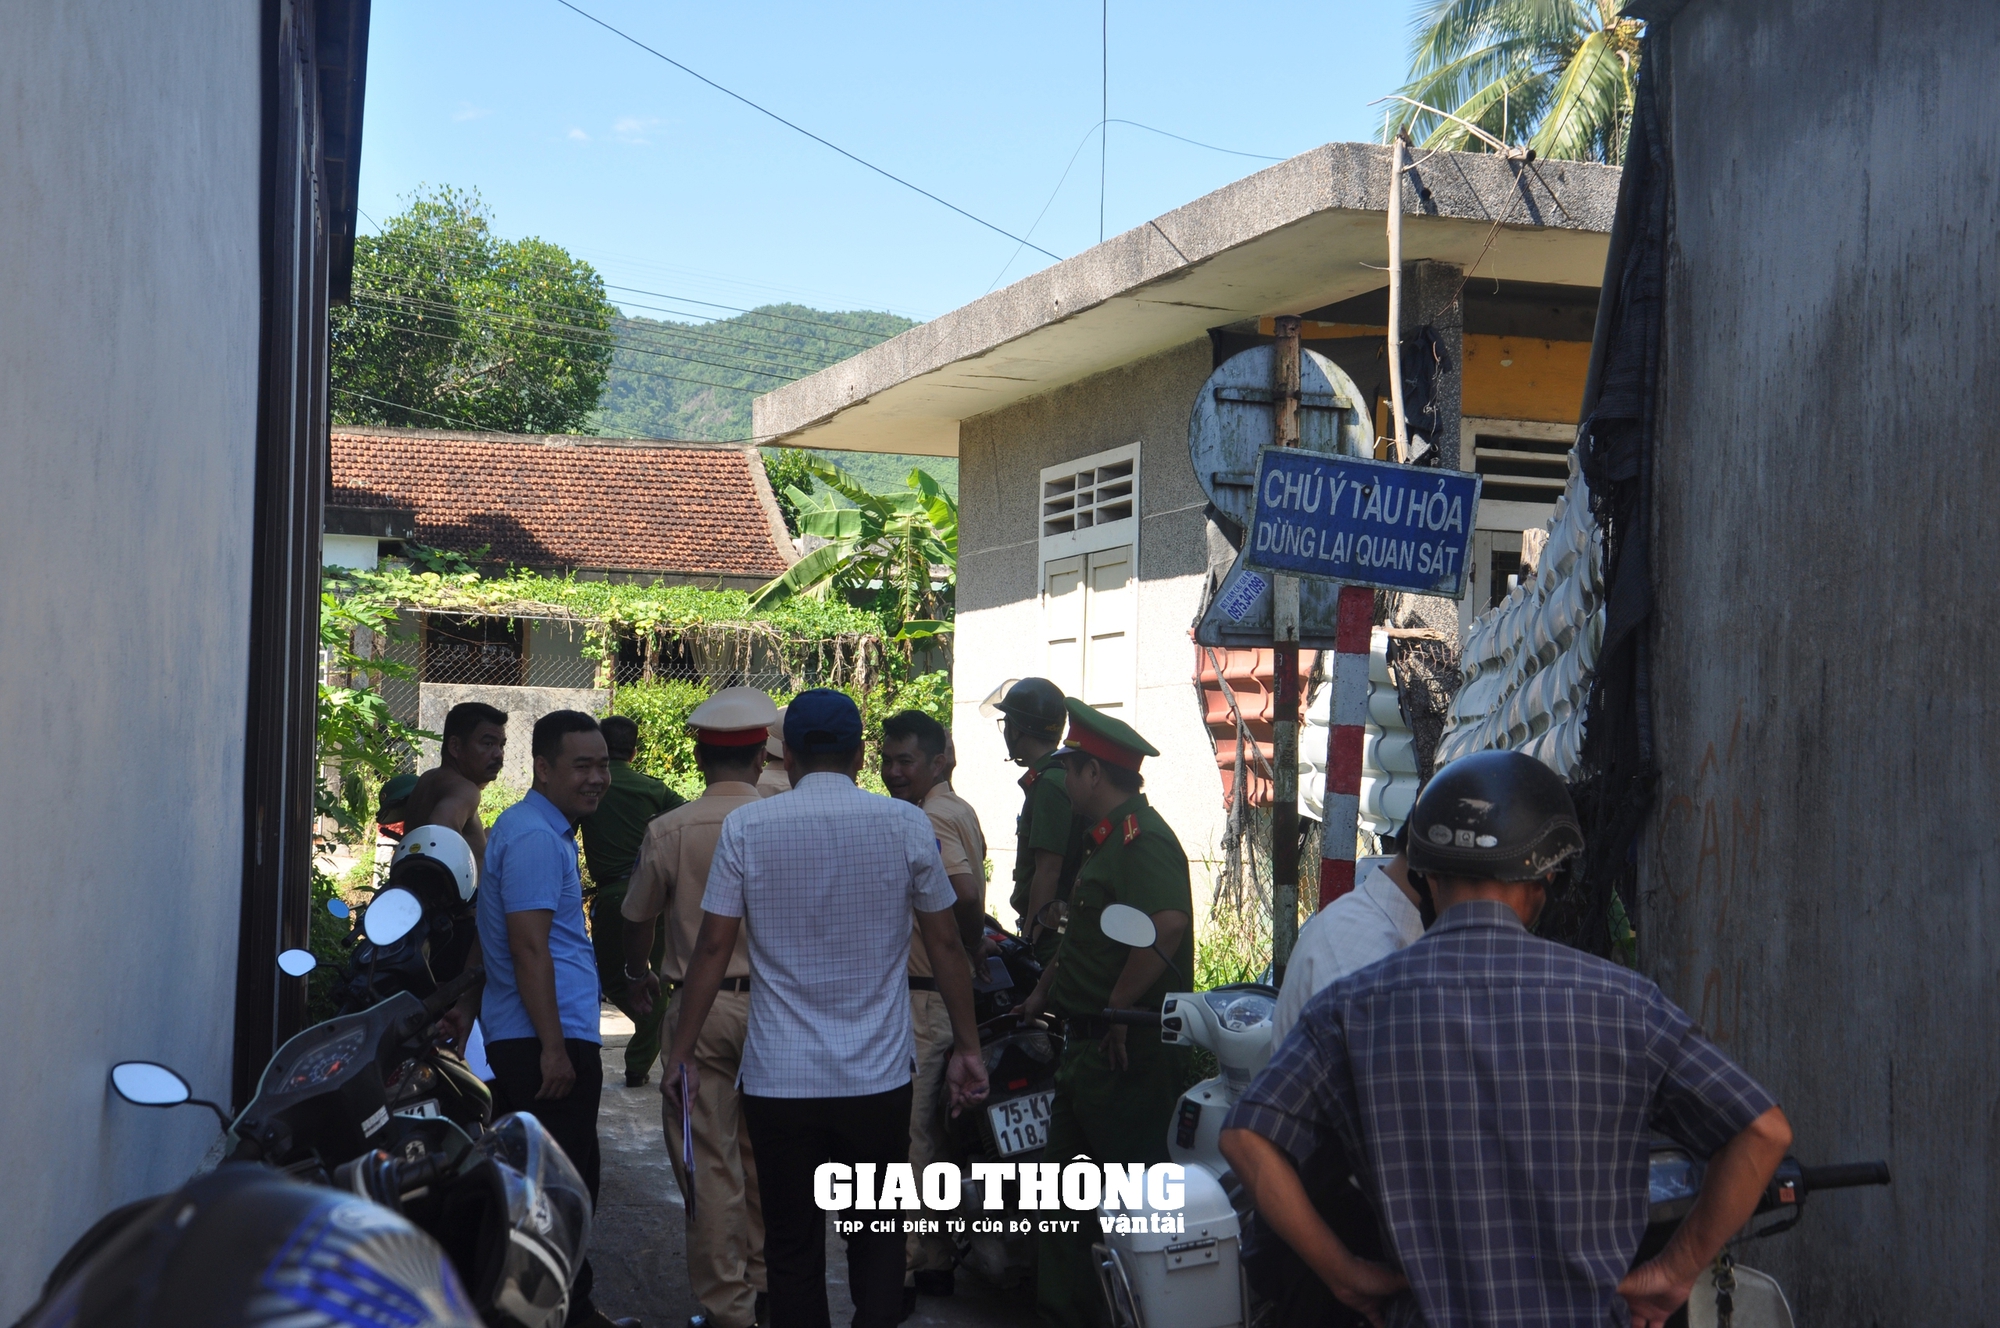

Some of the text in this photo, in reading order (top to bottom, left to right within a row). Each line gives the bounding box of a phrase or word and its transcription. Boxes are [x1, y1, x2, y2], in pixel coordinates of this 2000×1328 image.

[1263, 467, 1463, 534] CHÚ Ý TÀU HỎA
[1256, 516, 1459, 577] DỪNG LẠI QUAN SÁT
[1227, 576, 1266, 620] 0975.347.099
[999, 1094, 1051, 1127] 75-K1
